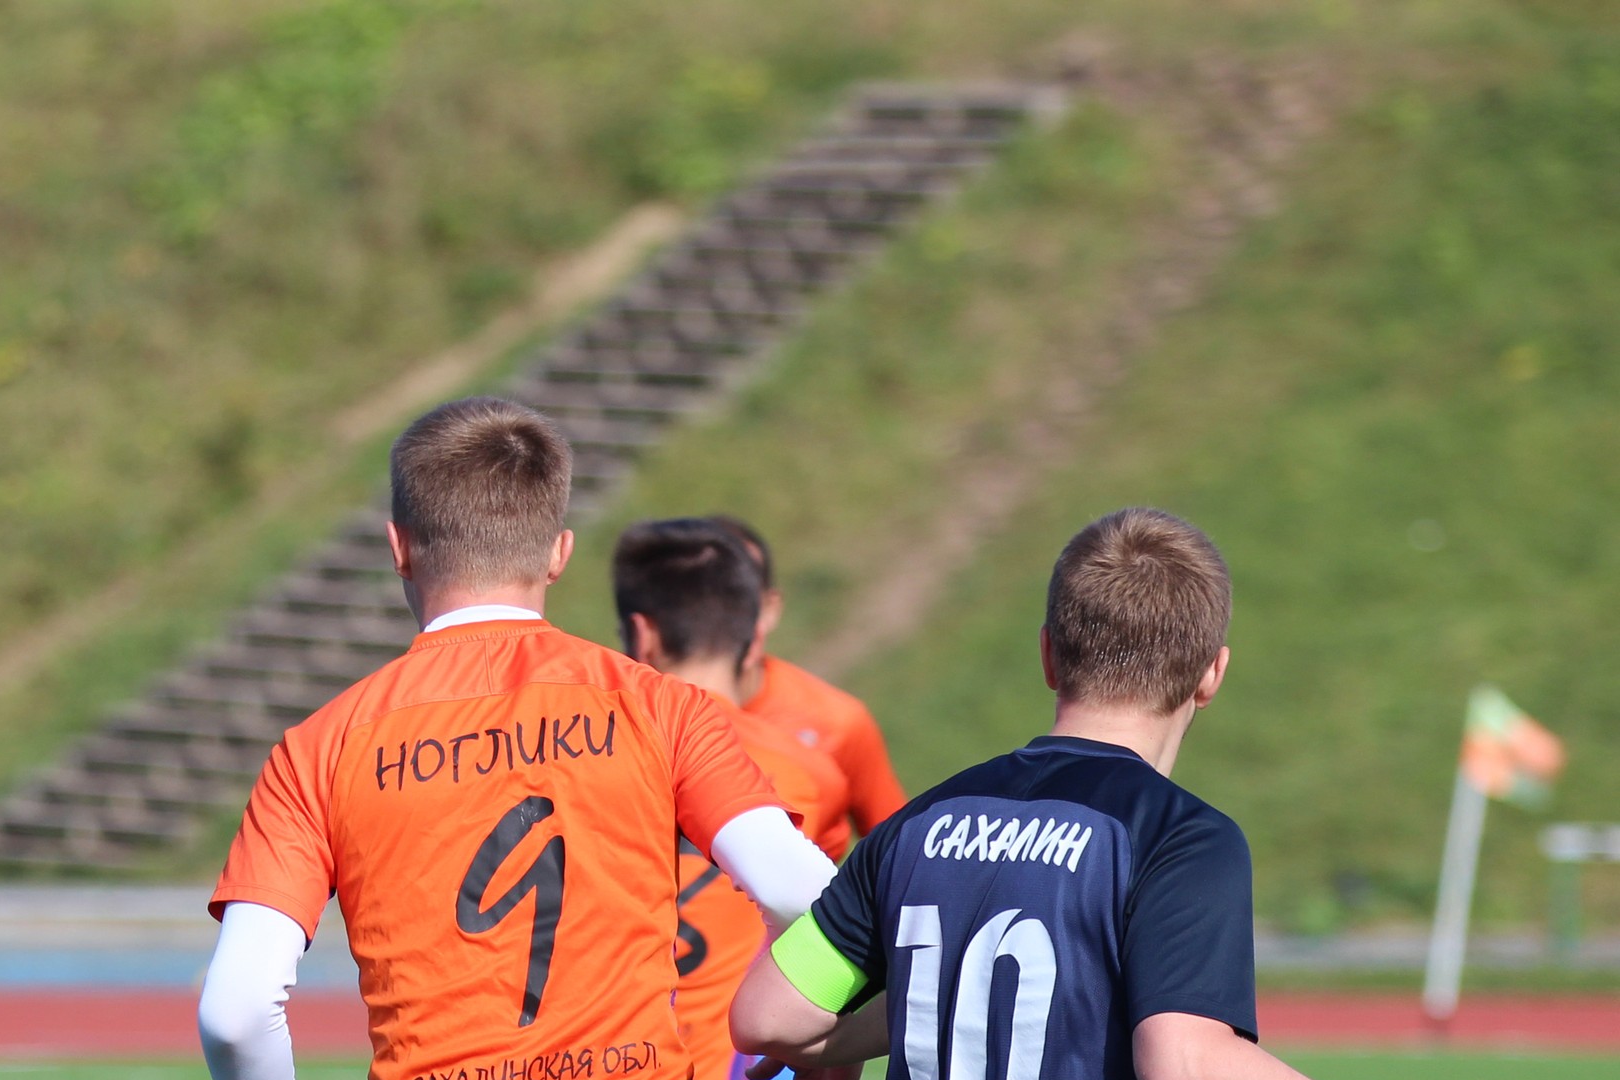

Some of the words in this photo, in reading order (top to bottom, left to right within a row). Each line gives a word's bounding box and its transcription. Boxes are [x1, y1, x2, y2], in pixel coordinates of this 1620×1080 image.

[376, 710, 615, 791] НОГЛИКИ
[924, 813, 1093, 873] САХАЛИН
[456, 795, 566, 1027] 9
[602, 1041, 662, 1075] ОБЛ.
